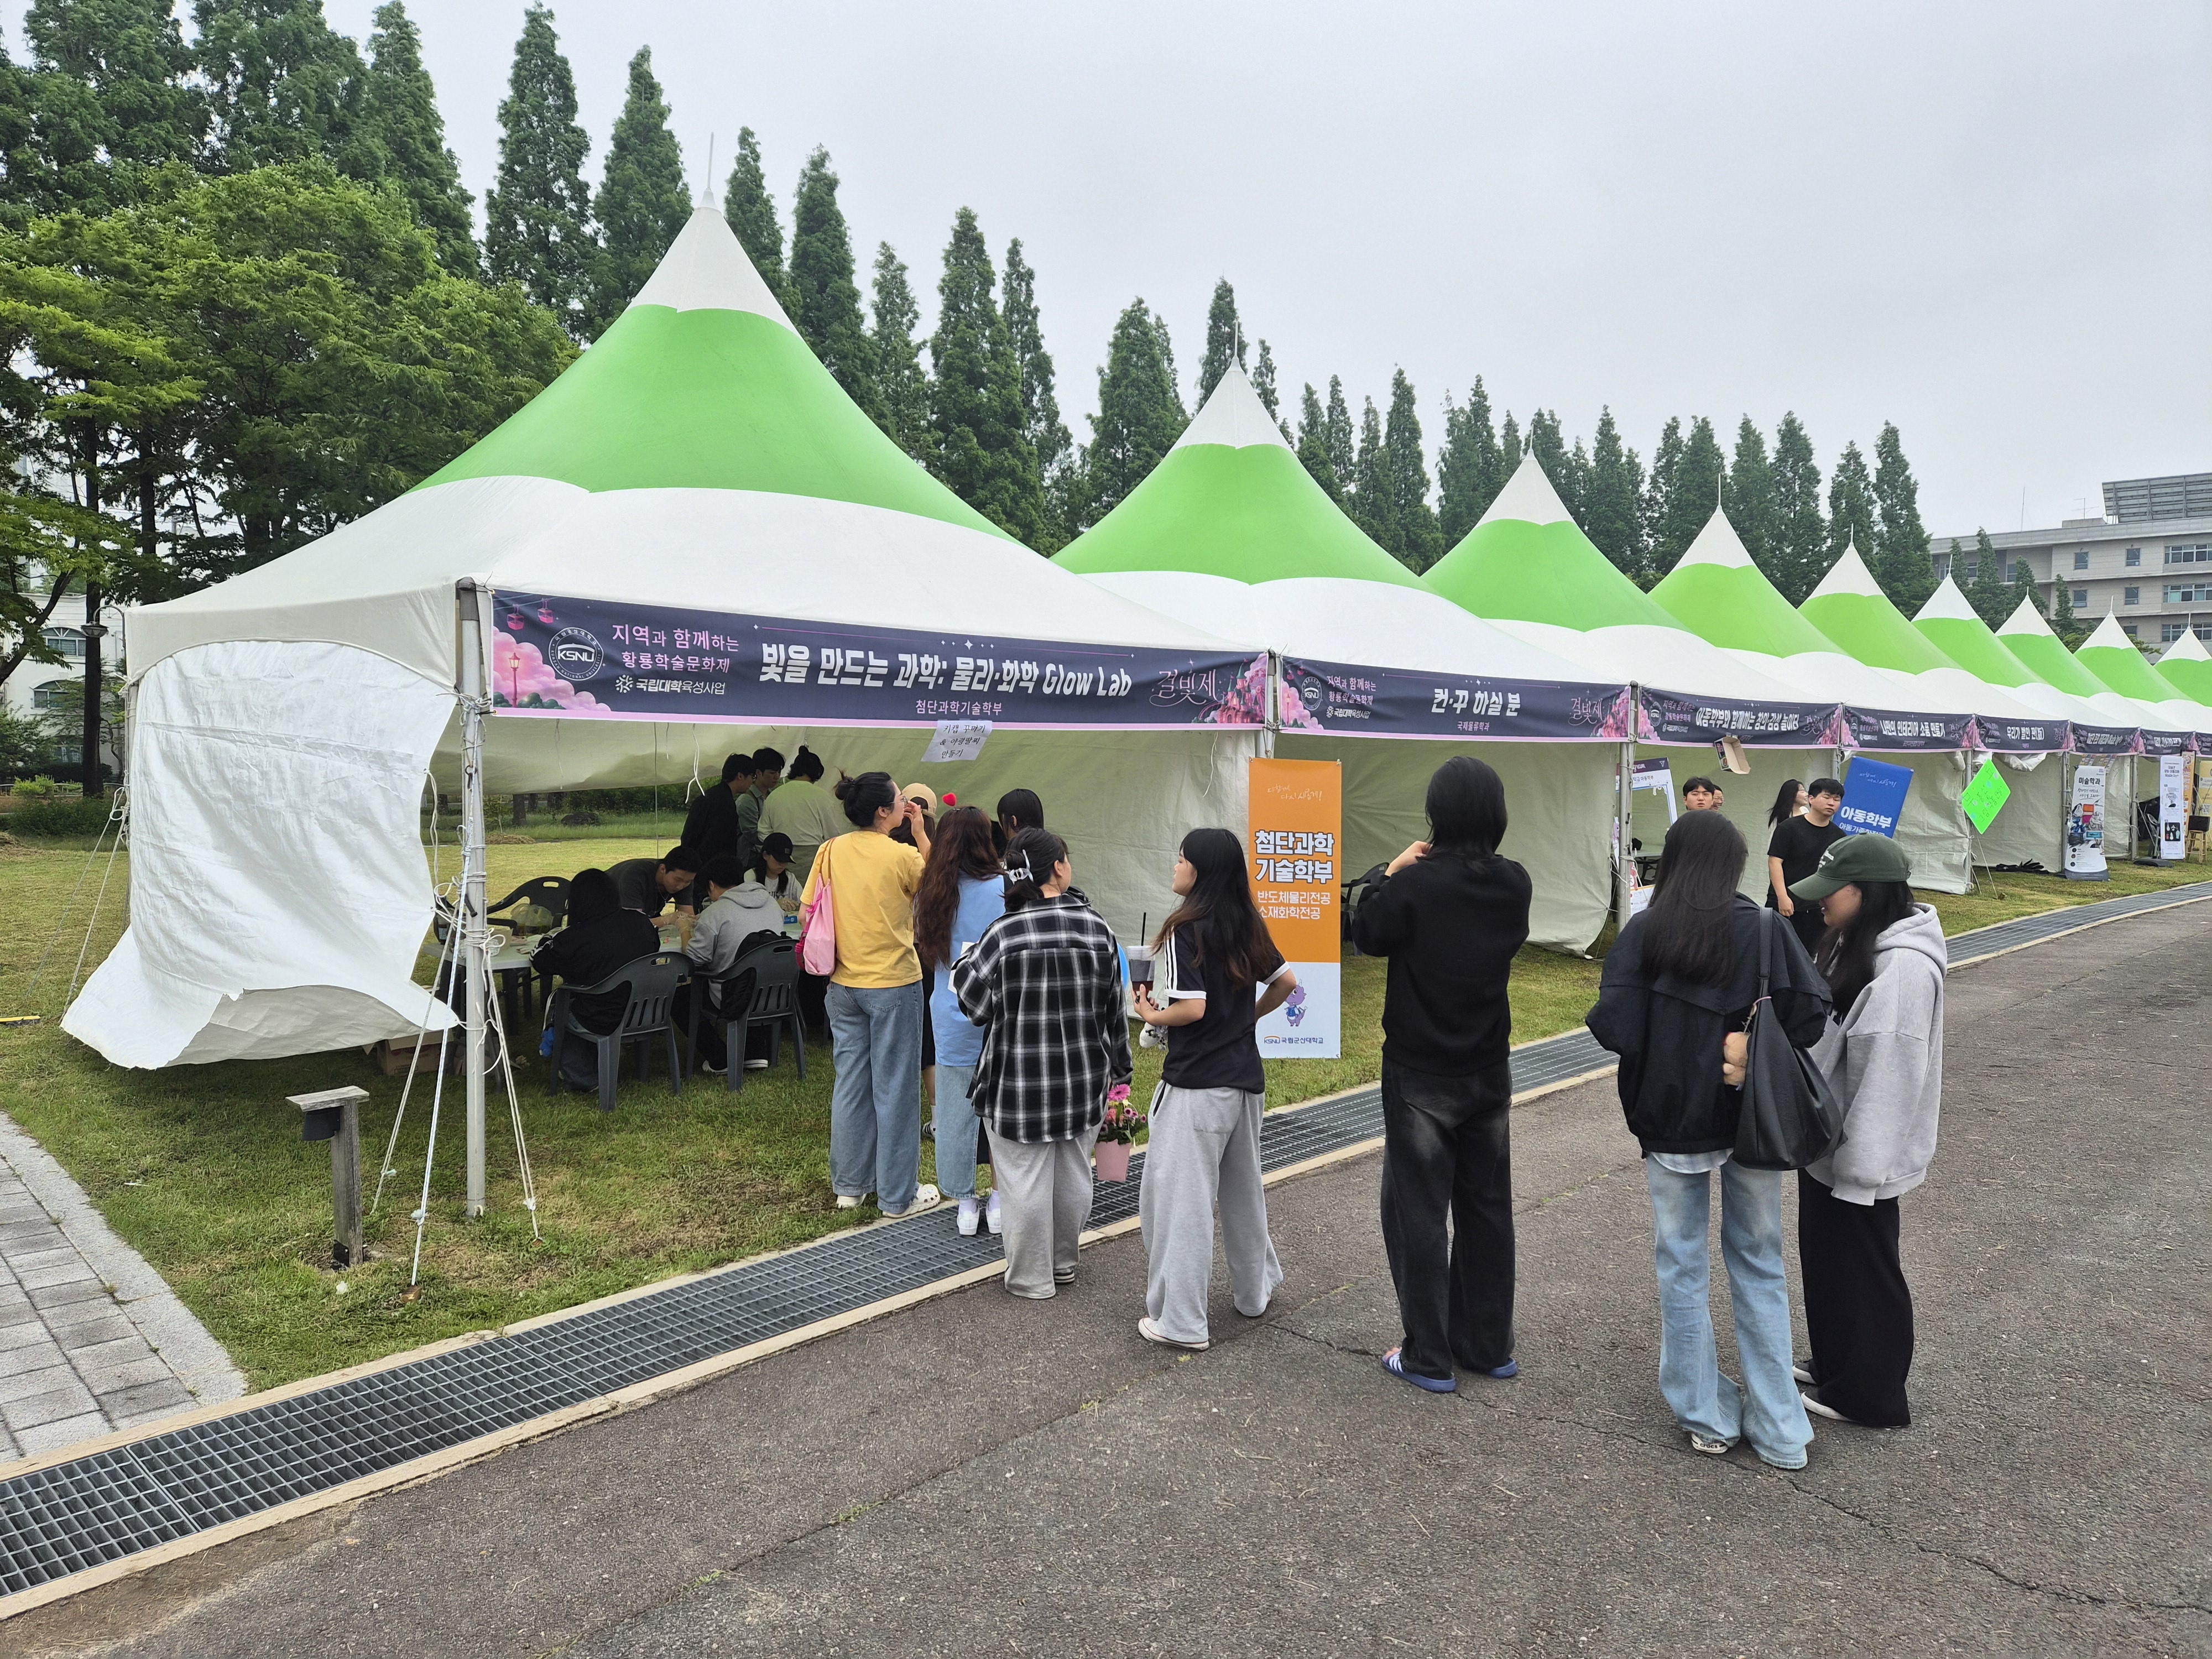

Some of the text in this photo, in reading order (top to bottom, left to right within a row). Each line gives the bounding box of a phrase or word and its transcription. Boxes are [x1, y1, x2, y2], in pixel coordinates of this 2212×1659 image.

[612, 624, 739, 652] 지역과 함께하는
[557, 649, 594, 662] KSNU
[620, 650, 730, 674] 황룡학술문화제
[560, 669, 585, 679] NATIONAL
[585, 654, 602, 677] UNIVERSITY
[759, 643, 811, 684] 빛을
[817, 648, 889, 687] 만드는
[1042, 663, 1093, 696] Glow
[1096, 666, 1133, 697] Lab
[635, 677, 726, 695] 국립대학육성사업
[1149, 667, 1222, 707] 결빛제
[1327, 675, 1376, 692] 지역과 함께하는
[915, 699, 1003, 716] 첨단과학기술학부
[1473, 690, 1503, 716] 하실
[1506, 692, 1521, 716] 분
[1568, 697, 1606, 726] 결빛제
[942, 724, 959, 734] 키캡
[1457, 721, 1490, 732] 국제물류학과
[1730, 710, 1755, 730] 함께하는
[1920, 722, 1931, 737] 소품
[1931, 722, 1945, 737] 만들기
[2007, 726, 2021, 739] 우리가
[941, 749, 964, 759] 만들기
[2079, 777, 2100, 785] 미술학과
[1840, 806, 1893, 829] 아동학부
[1255, 830, 1334, 856] 첨단과학
[1255, 859, 1333, 884] 기술학부
[1258, 891, 1331, 904] 반도체물리전공
[1259, 906, 1321, 920] 소재화학전공
